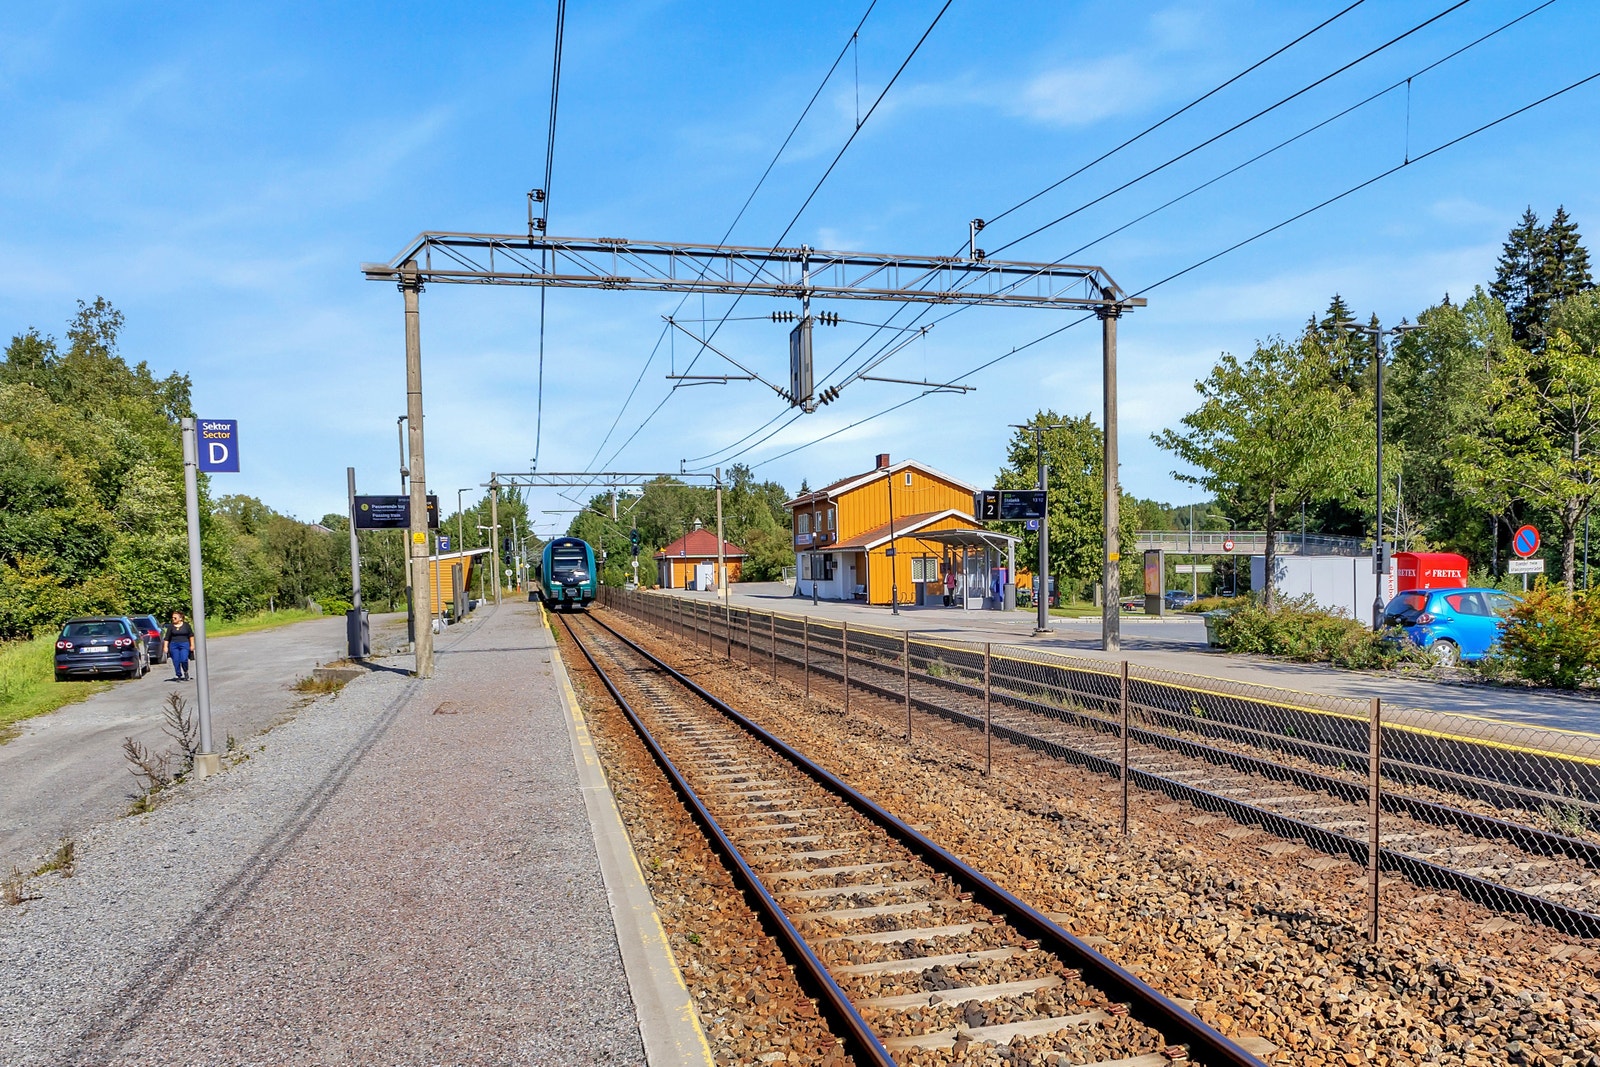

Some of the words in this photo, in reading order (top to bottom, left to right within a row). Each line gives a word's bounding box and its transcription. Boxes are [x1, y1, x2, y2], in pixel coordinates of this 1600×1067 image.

[202, 421, 231, 430] Sektor
[203, 430, 230, 439] Sector
[209, 442, 228, 464] D
[987, 505, 994, 515] 2
[441, 541, 447, 549] C
[1397, 569, 1416, 577] RETEX
[1432, 569, 1462, 578] FRETEX
